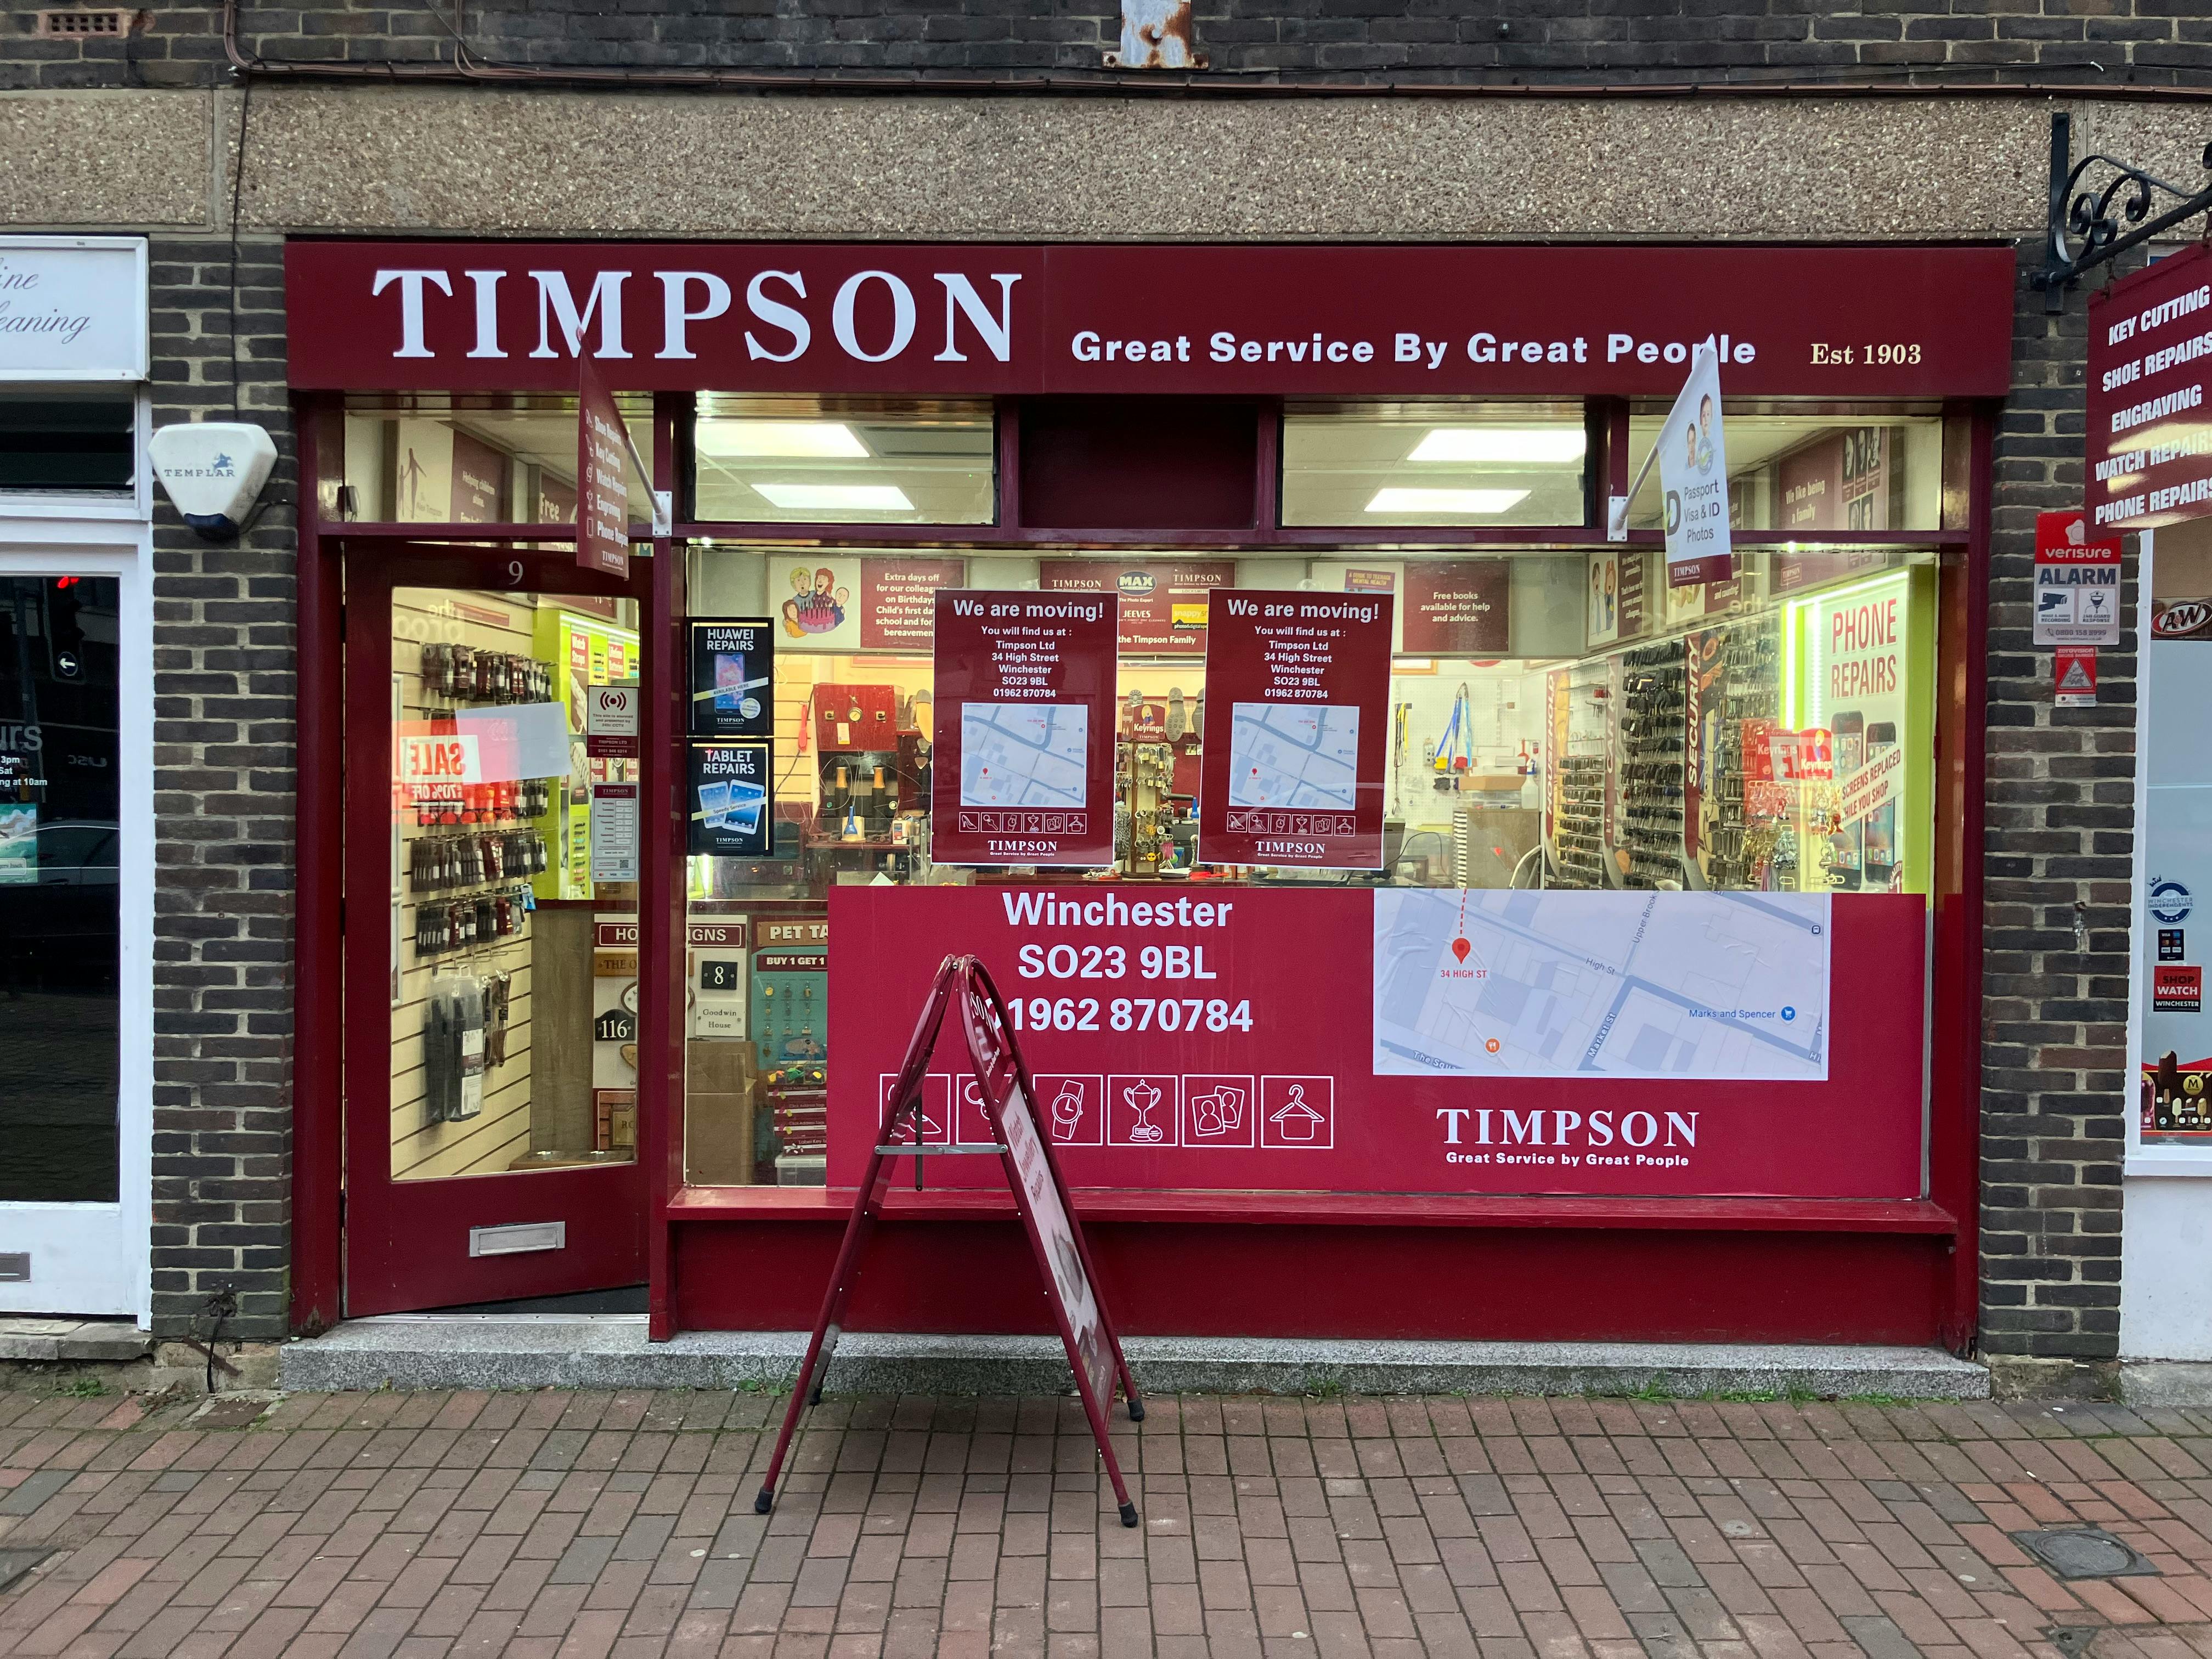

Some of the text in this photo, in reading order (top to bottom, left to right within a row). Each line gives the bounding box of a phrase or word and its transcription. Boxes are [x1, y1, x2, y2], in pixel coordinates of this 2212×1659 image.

[373, 269, 1022, 362] TIMPSON
[2108, 284, 2210, 346] KEY CUTTING
[1071, 331, 1190, 363] Great
[1209, 331, 1374, 363] Service
[1395, 334, 1447, 370] By
[1466, 333, 1588, 364] Great
[1810, 343, 1921, 365] Est 1903
[2102, 331, 2212, 392] SHOE REPAIRS
[2112, 385, 2202, 433] ENGRAVING
[2095, 428, 2212, 481] WATCH REPAIR
[164, 469, 235, 477] TEMPLAR
[1684, 479, 1719, 501] Passport
[1795, 485, 1807, 500] like
[1807, 479, 1825, 499] being
[539, 492, 560, 522] Free
[1684, 507, 1699, 523] Visa
[1701, 505, 1707, 518] &
[1709, 502, 1720, 517] ID
[2095, 494, 2145, 525] PHONE
[1792, 504, 1816, 524] a family
[1687, 527, 1714, 544] Photos
[2045, 548, 2112, 558] verisure
[509, 561, 524, 585] 9
[1674, 564, 1700, 577] TIMPSON
[2039, 568, 2116, 585] ALARM
[885, 573, 906, 581] Extra
[908, 573, 926, 583] days
[1052, 579, 1102, 588] TIMPSON
[1119, 576, 1153, 586] MAX
[1173, 574, 1222, 582] TIMPSON
[905, 585, 947, 594] colleag
[1433, 591, 1479, 601] Free books
[876, 606, 903, 614] Child's
[953, 600, 1104, 622] We are moving!
[1227, 599, 1379, 623] We are moving!
[1420, 603, 1490, 613] available for help
[876, 617, 902, 625] school
[1432, 614, 1479, 623] and advice.
[981, 626, 1000, 635] You
[1002, 627, 1020, 635] will
[1022, 627, 1040, 635] find
[1832, 597, 1897, 654] PHONE
[707, 629, 754, 640] HUAWEI
[1132, 635, 1168, 644] Timpson
[1170, 636, 1197, 645] Family
[707, 640, 754, 651] REPAIRS
[996, 640, 1055, 651] Timpson Ltd
[991, 653, 1059, 663] 34 High Street
[998, 664, 1052, 674] Winchester
[1002, 677, 1048, 686] SO23 9BL
[1274, 677, 1321, 686] SO23 9BL
[1831, 654, 1897, 699] REPAIRS
[993, 689, 1057, 698] 01962 870784
[1265, 689, 1329, 698] 01962 870784
[1688, 636, 1700, 788] SECURITY
[1133, 723, 1164, 733] Keyrings
[1, 756, 20, 765] 3pm
[705, 749, 753, 762] TABLET
[703, 763, 755, 774] REPAIRS
[1801, 758, 1832, 772] Keyrings
[1842, 748, 1901, 800] SCREENS REPLACED
[1858, 793, 1871, 812] YOU
[1872, 780, 1889, 804] SHOP
[988, 840, 1058, 851] TIMPSON
[1255, 841, 1326, 854] TIMPSON
[1002, 892, 1233, 927] Winchester
[1633, 894, 1657, 944] Upper Brook
[770, 925, 828, 940] PET TA
[605, 960, 626, 969] THE
[766, 957, 825, 965] BUY 1 GET 1
[1017, 944, 1217, 980] SO23 9BL
[1585, 957, 1616, 975] High St
[714, 966, 724, 985] 8
[1440, 969, 1487, 979] 34 HIGH ST
[2163, 975, 2194, 984] SHOP
[2157, 986, 2198, 995] WATCH
[1110, 998, 1254, 1032] 870784
[1689, 1009, 1776, 1020] Marks and Spencer
[601, 1019, 628, 1039] 116
[1587, 1012, 1616, 1058] Market St
[1412, 1050, 1431, 1064] The
[1436, 1108, 1700, 1148] TIMPSON
[1446, 1152, 1690, 1168] Great Service by Great People
